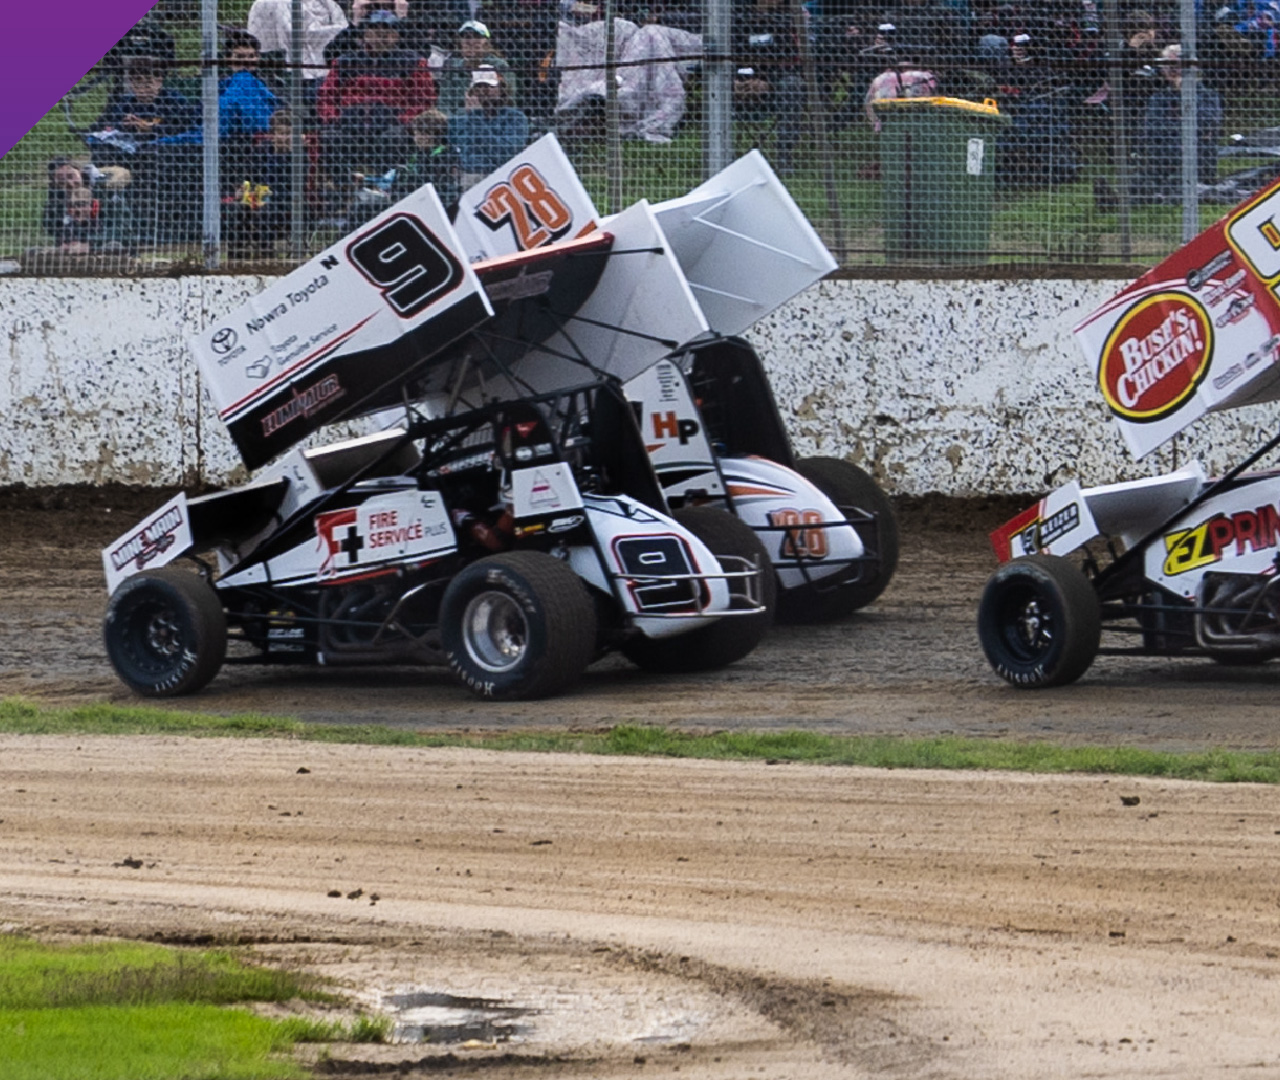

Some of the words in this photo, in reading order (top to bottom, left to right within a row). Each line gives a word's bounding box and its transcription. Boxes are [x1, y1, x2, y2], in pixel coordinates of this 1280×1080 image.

[345, 212, 465, 320] 9
[245, 302, 288, 336] Nowra
[285, 273, 330, 310] Toyota
[369, 510, 398, 529] FIRE
[369, 524, 423, 549] SERVICE
[424, 523, 448, 539] PLUS
